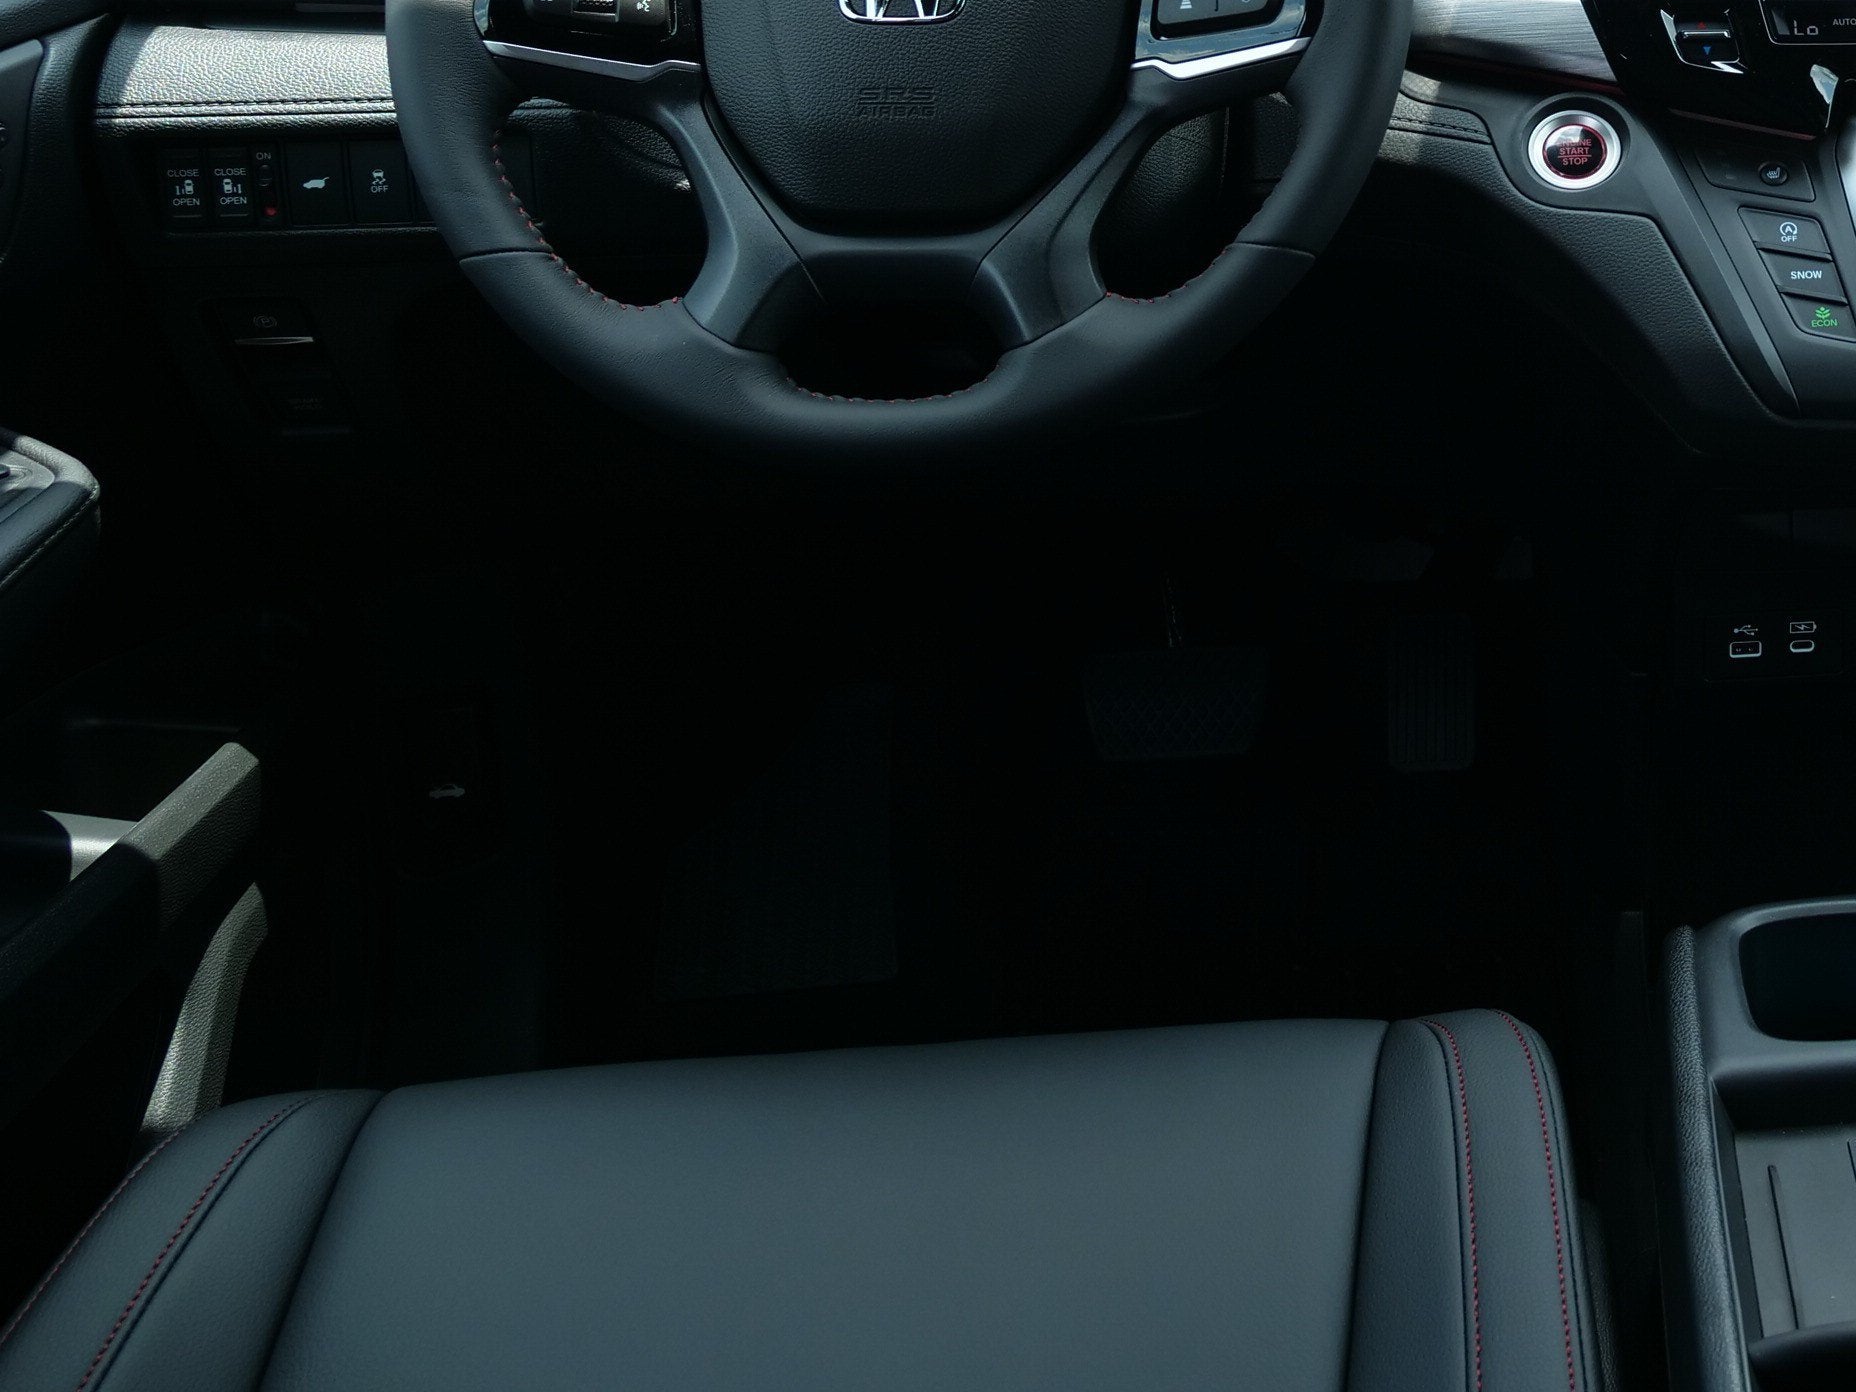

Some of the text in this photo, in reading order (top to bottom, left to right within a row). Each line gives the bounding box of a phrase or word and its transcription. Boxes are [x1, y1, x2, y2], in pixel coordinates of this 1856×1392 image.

[1559, 147, 1590, 156] START
[256, 152, 272, 160] ON
[1562, 157, 1588, 166] STOP
[167, 169, 200, 177] CLOSE
[214, 168, 247, 176] CLOSE
[370, 185, 389, 193] OFF
[172, 198, 200, 206] OPEN
[219, 197, 247, 205] OPEN
[1781, 235, 1798, 243] OFF
[1790, 270, 1822, 279] SNOW
[1811, 319, 1838, 327] ECON
